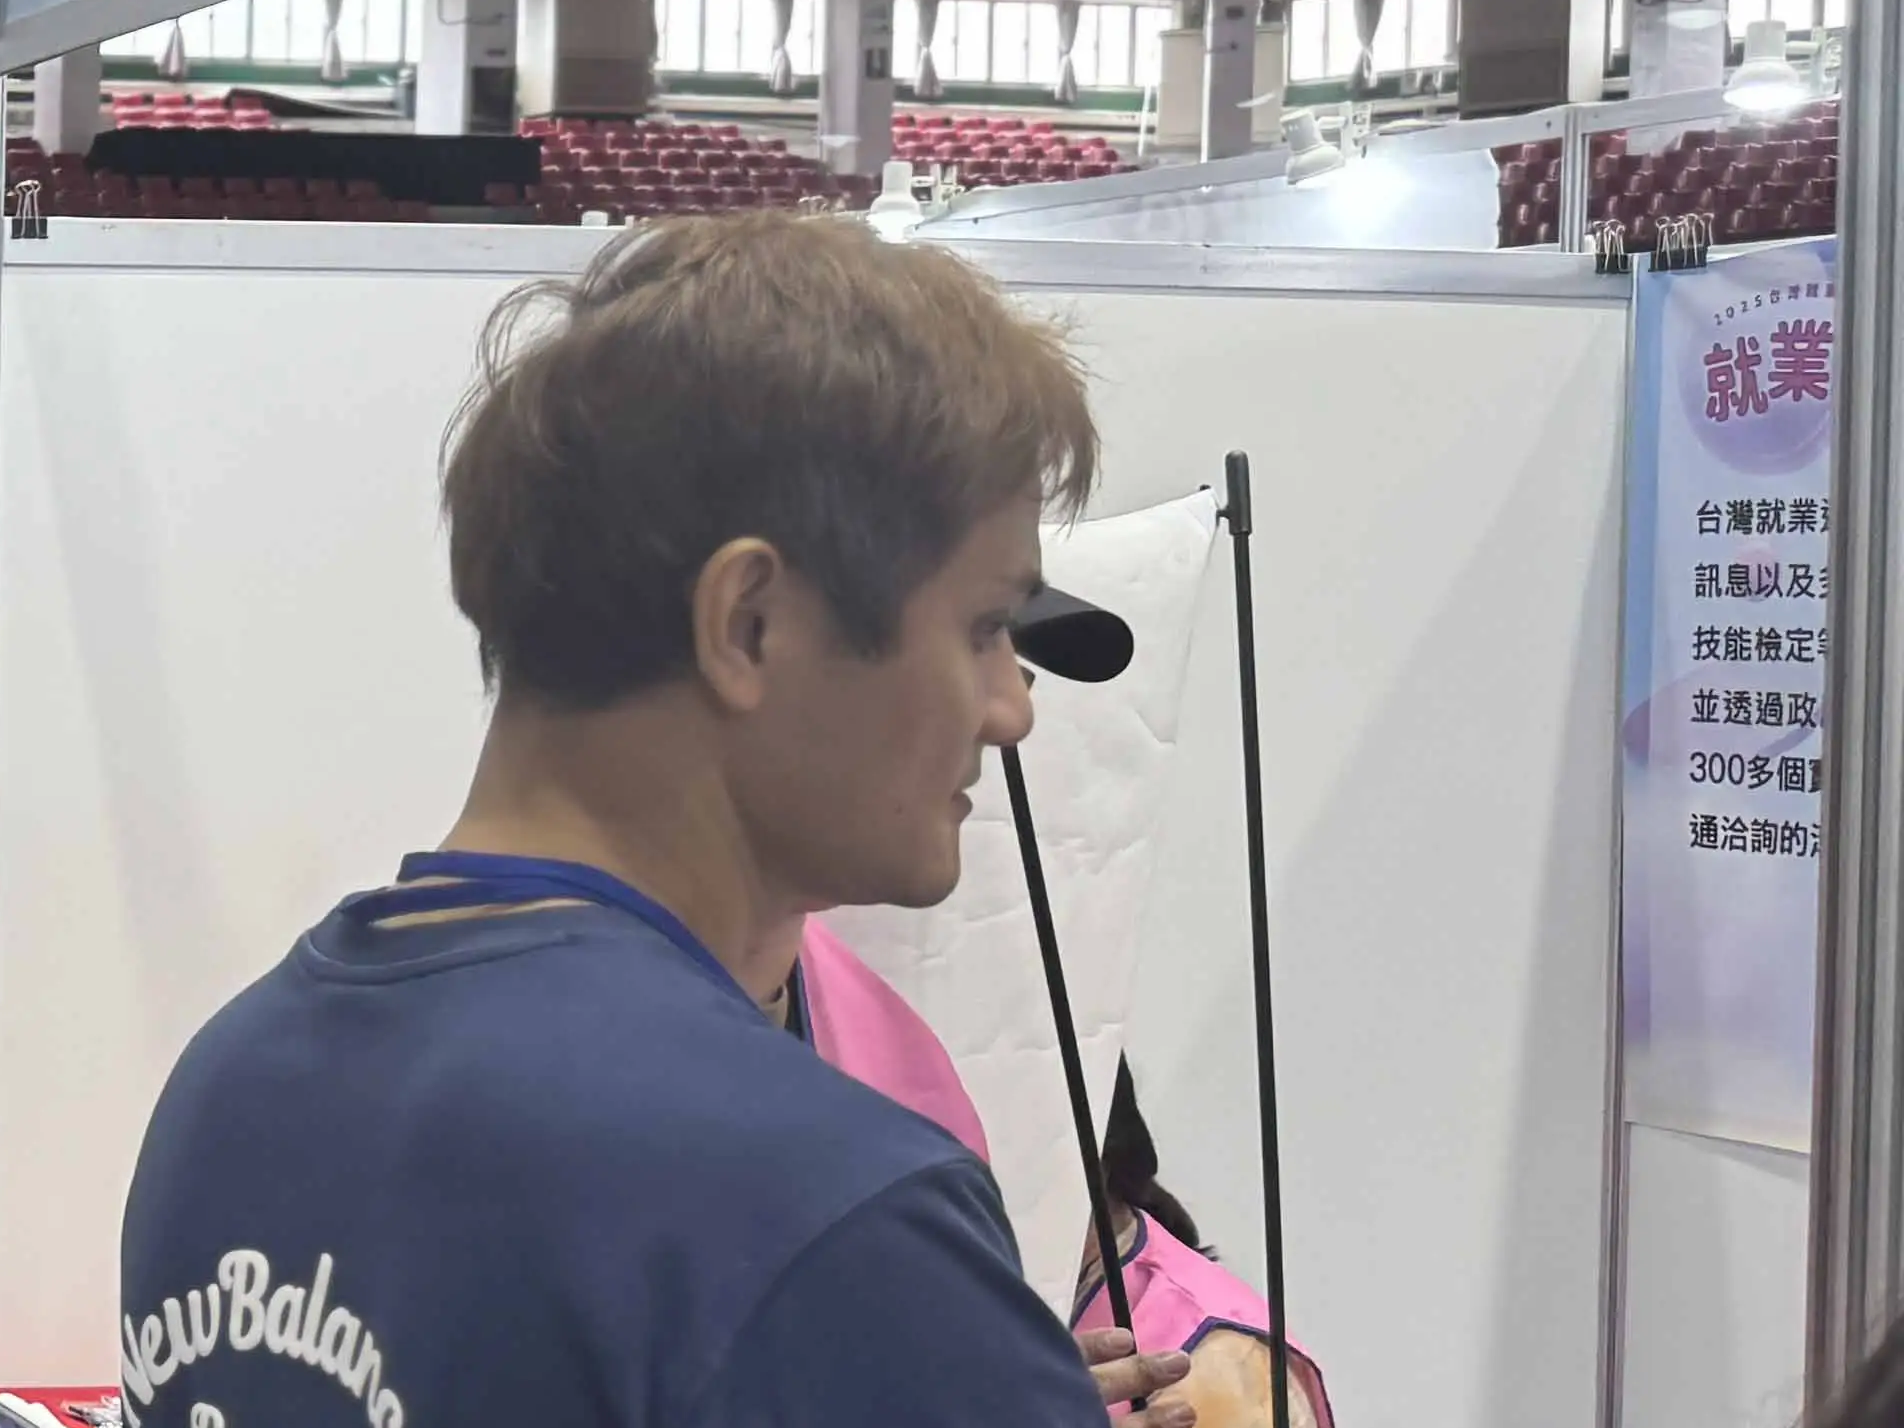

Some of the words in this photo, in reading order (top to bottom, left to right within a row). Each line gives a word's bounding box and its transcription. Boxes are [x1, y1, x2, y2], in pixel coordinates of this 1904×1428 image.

[1703, 319, 1833, 422] 就業
[1690, 688, 1823, 728] 並透過政
